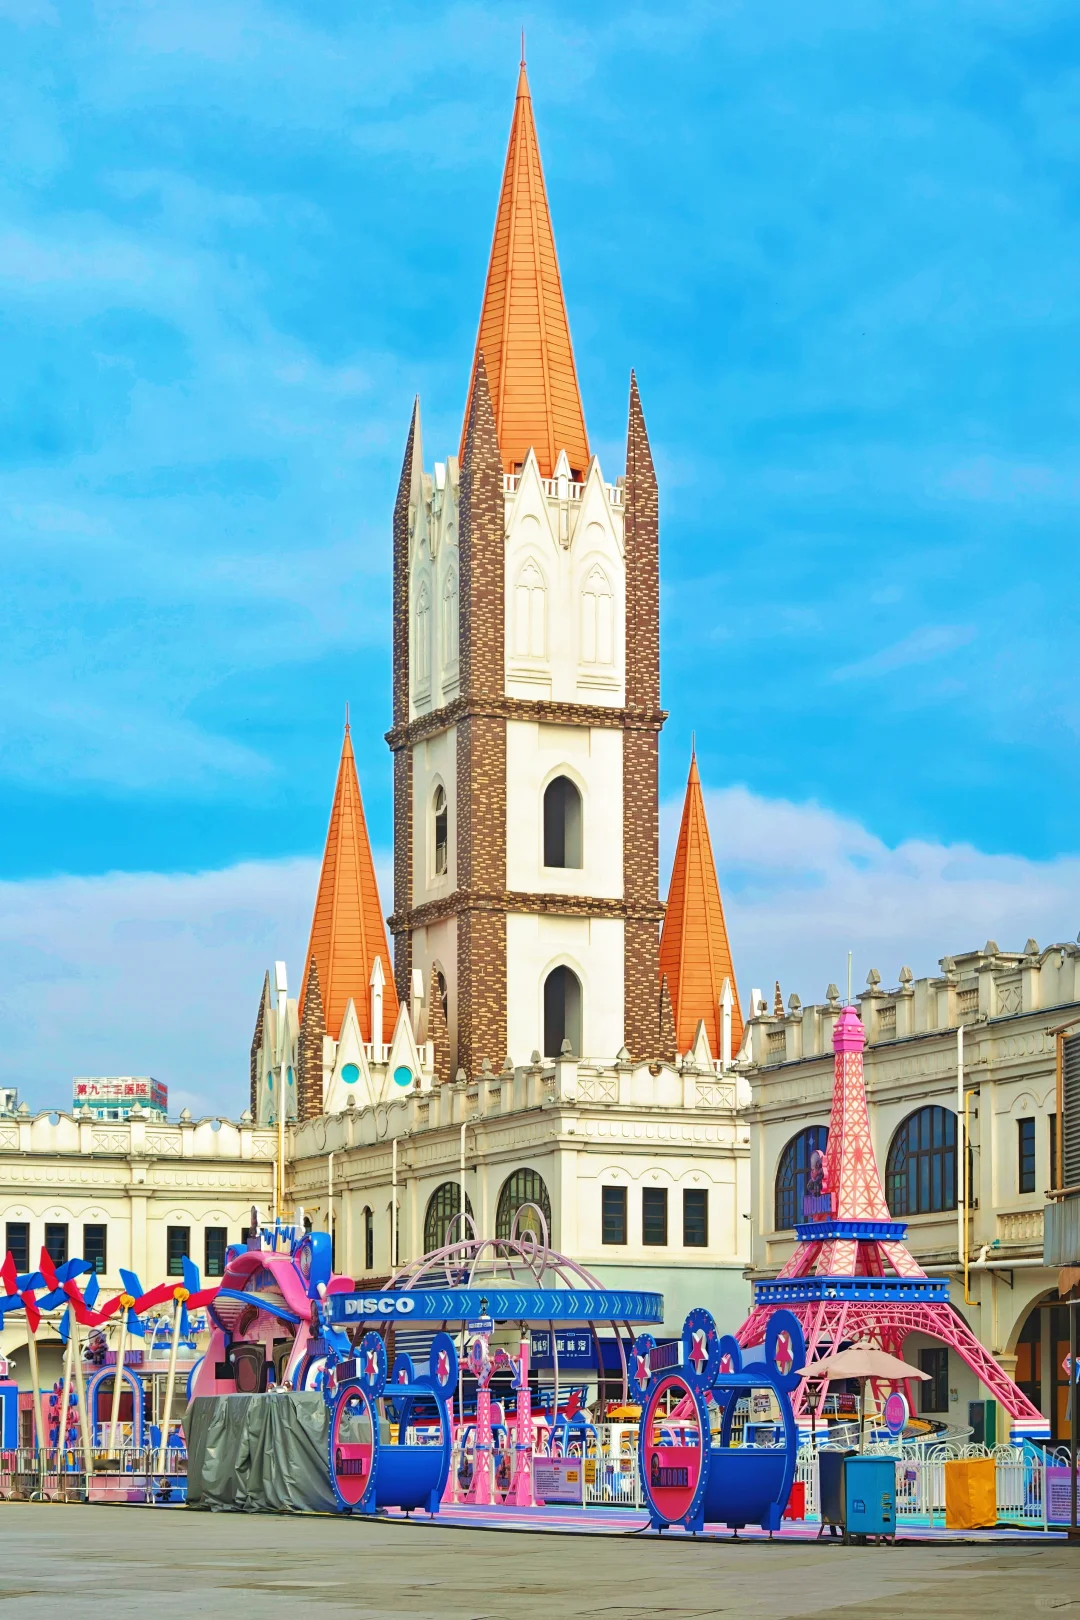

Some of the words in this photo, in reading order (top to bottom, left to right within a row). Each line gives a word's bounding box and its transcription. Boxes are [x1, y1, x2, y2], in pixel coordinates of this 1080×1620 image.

[344, 1297, 415, 1314] DISCO
[106, 1350, 142, 1364] MONE
[660, 1468, 687, 1486] MOONE
